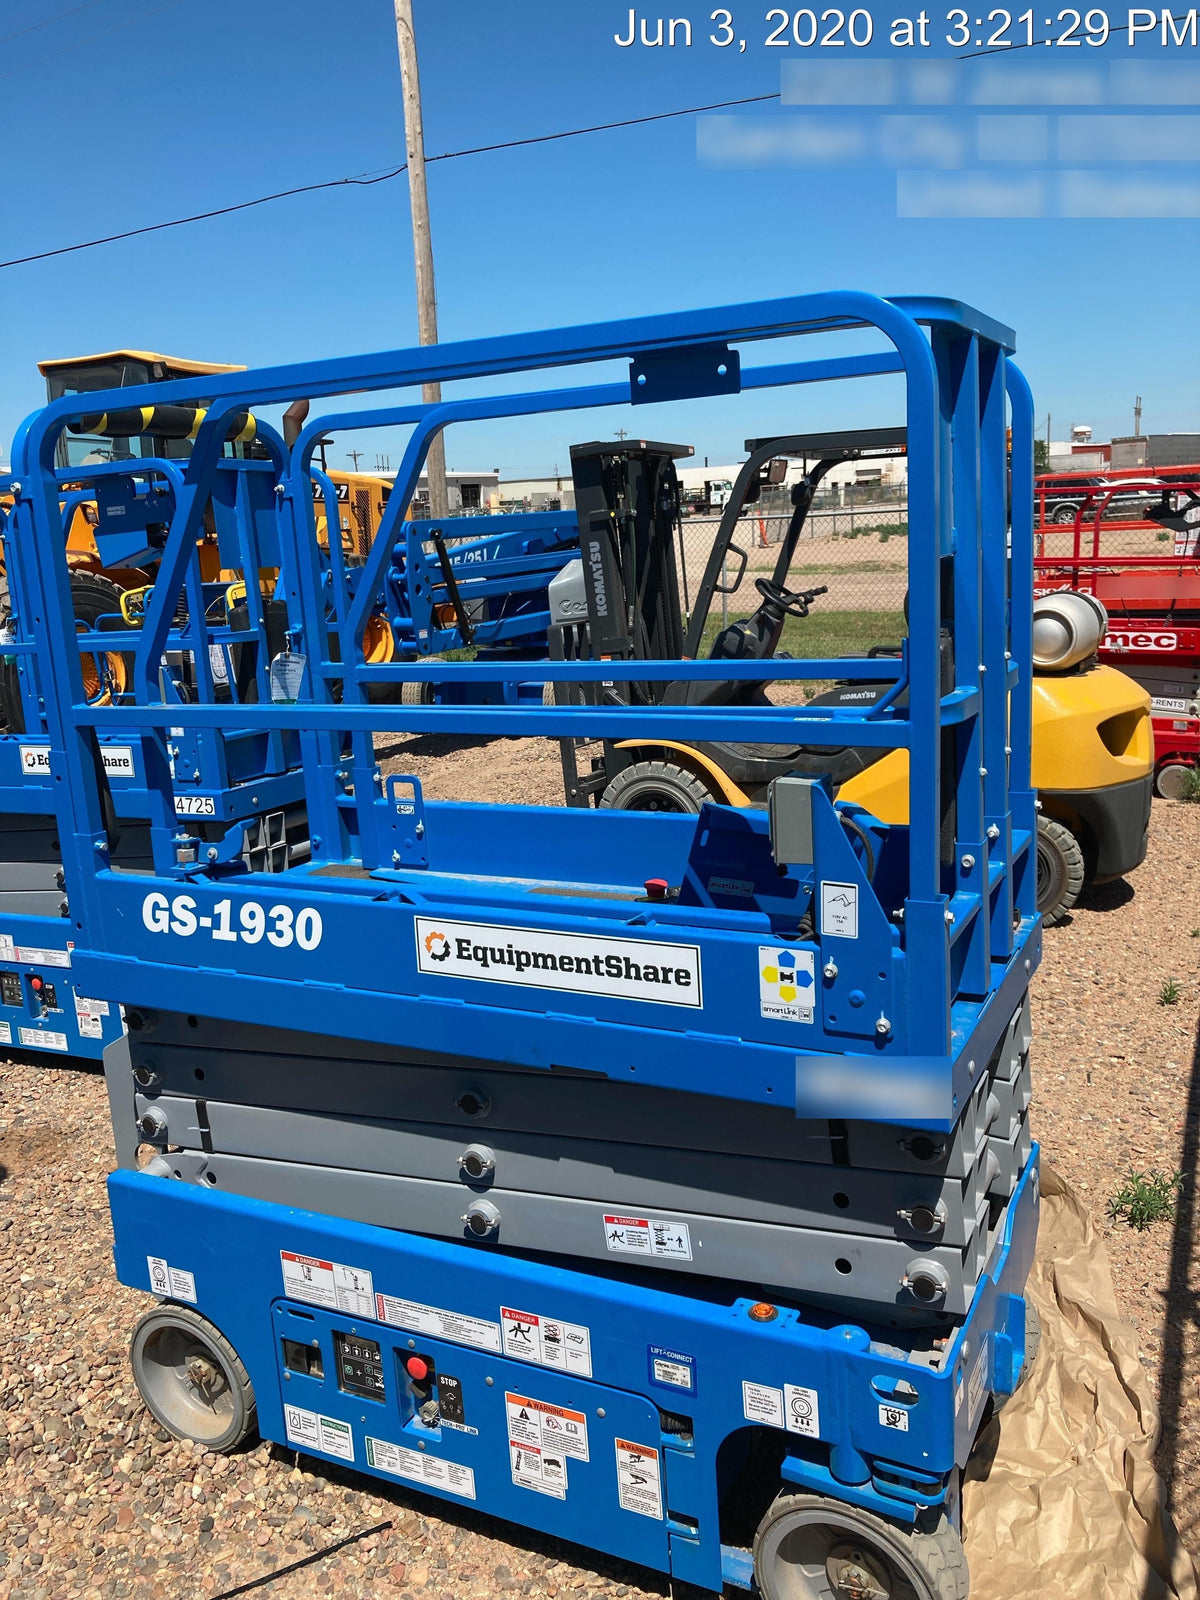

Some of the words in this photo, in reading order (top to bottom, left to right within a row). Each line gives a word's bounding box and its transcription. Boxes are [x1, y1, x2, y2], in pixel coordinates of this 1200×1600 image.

[589, 541, 608, 616] KOMATSU
[1101, 634, 1176, 648] mec
[840, 691, 876, 700] KOMATSU
[1151, 699, 1184, 708] -RENTS
[176, 797, 214, 815] 4725
[142, 892, 323, 951] GS-1930
[455, 937, 692, 987] EquipmentShare
[618, 1218, 640, 1226] DANGER
[300, 1257, 321, 1267] DANGER
[511, 1313, 536, 1323] DANGER
[667, 1351, 693, 1363] CONNECT
[440, 1376, 458, 1387] STOP
[533, 1401, 564, 1416] WARNING
[626, 1444, 654, 1457] WARNING
